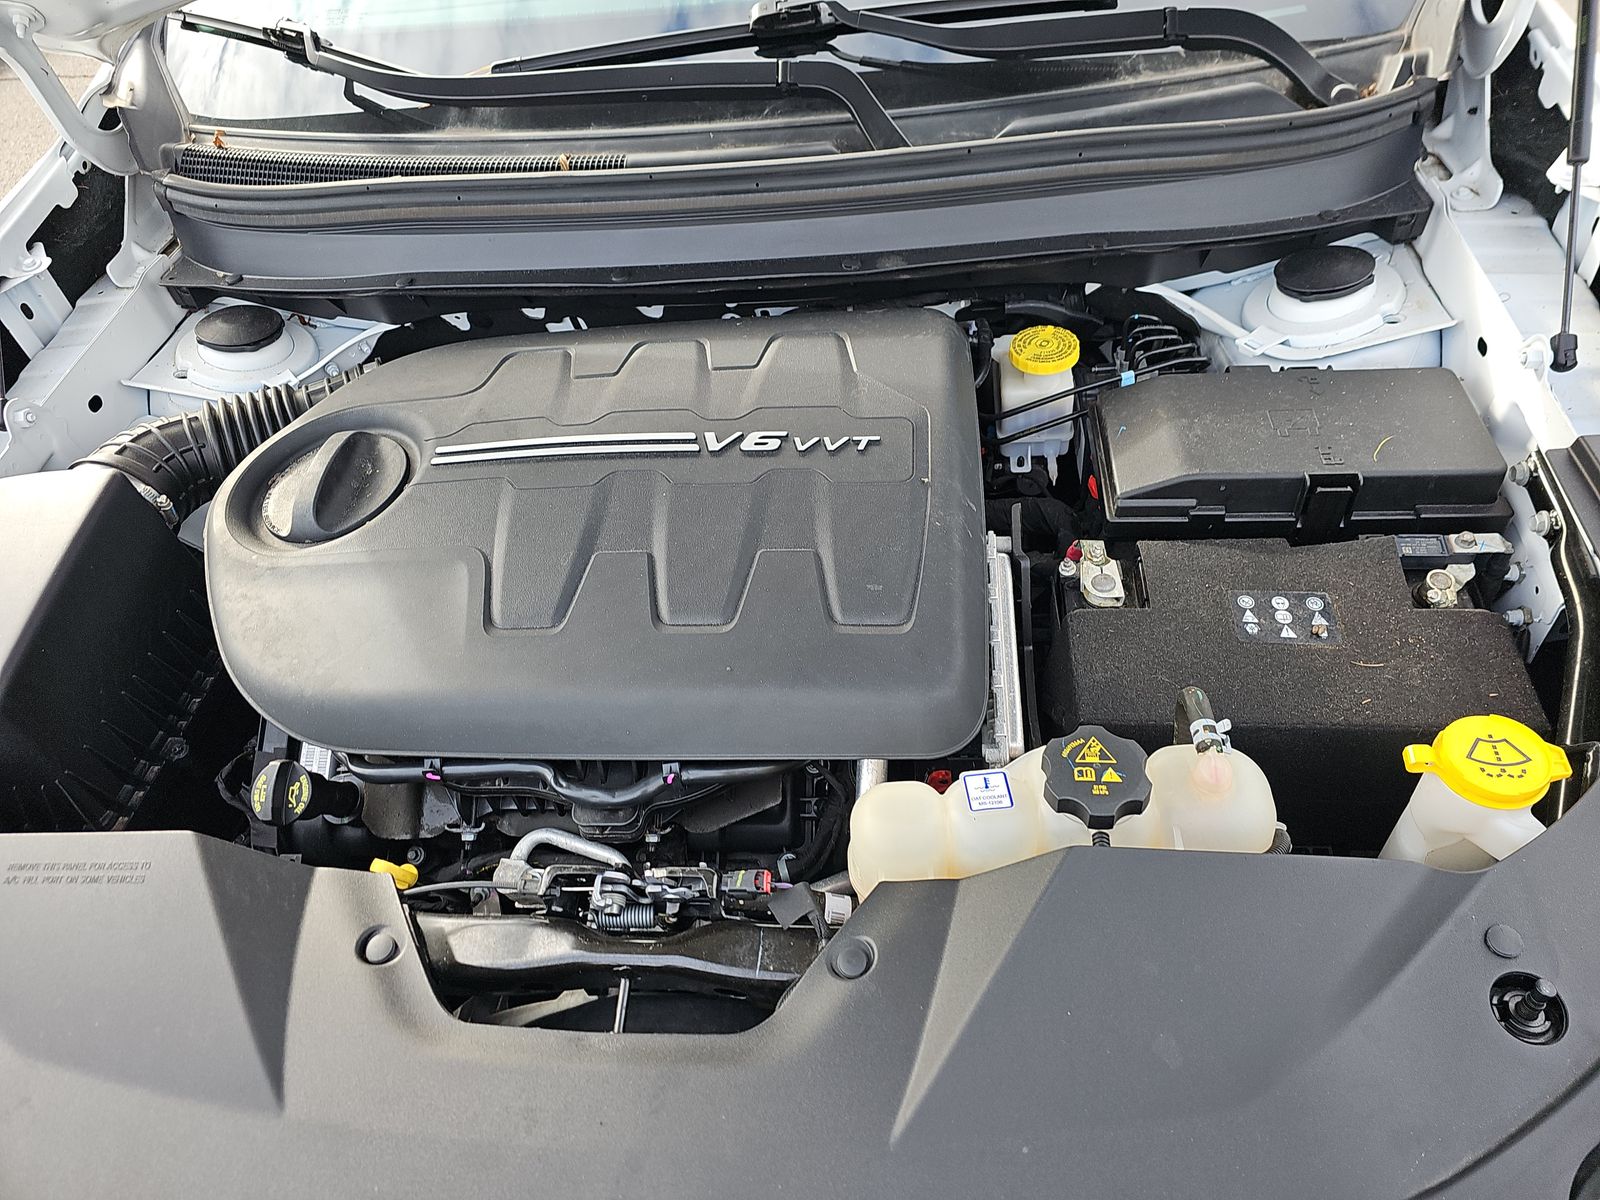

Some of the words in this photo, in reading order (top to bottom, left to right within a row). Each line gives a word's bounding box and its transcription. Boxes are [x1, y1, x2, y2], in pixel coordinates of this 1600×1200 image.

[704, 431, 789, 452] V6
[793, 435, 882, 452] VVT
[299, 774, 309, 802] ENGINE
[982, 793, 1008, 801] COOLANT
[293, 802, 306, 815] OIL
[7, 862, 40, 871] REMOVE
[43, 862, 61, 871] THIS
[61, 862, 88, 871] PANEL
[88, 862, 106, 871] FOR
[106, 862, 140, 871] ACCESS
[140, 861, 152, 871] TO
[3, 875, 20, 885] A/C
[22, 875, 39, 885] FILL
[41, 875, 64, 885] PORT
[66, 875, 80, 884] ON
[80, 875, 105, 884] SOME
[107, 875, 146, 884] VEHICLES
